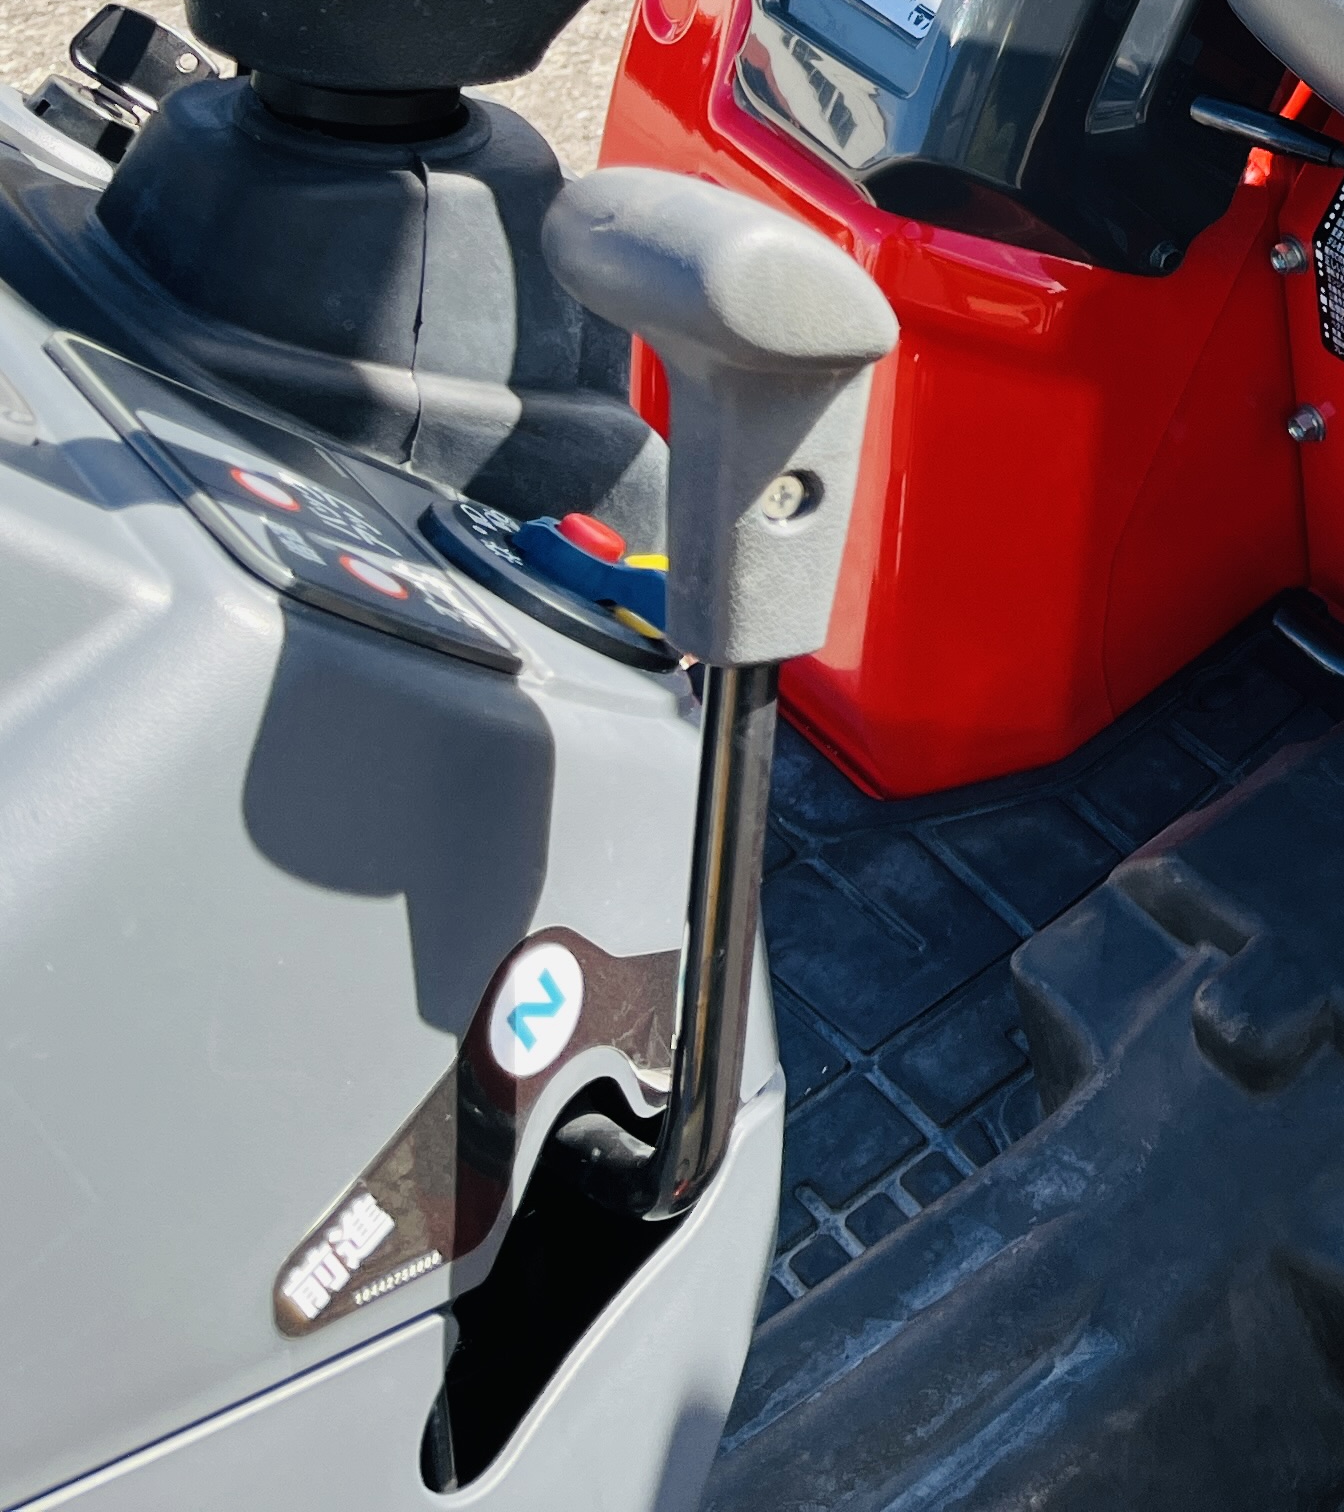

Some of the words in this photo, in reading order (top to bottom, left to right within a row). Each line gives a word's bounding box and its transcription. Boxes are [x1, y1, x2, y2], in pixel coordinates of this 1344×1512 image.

[270, 468, 364, 541] バック
[310, 484, 405, 558] アップ
[505, 966, 565, 1054] N
[283, 1193, 395, 1320] 前進
